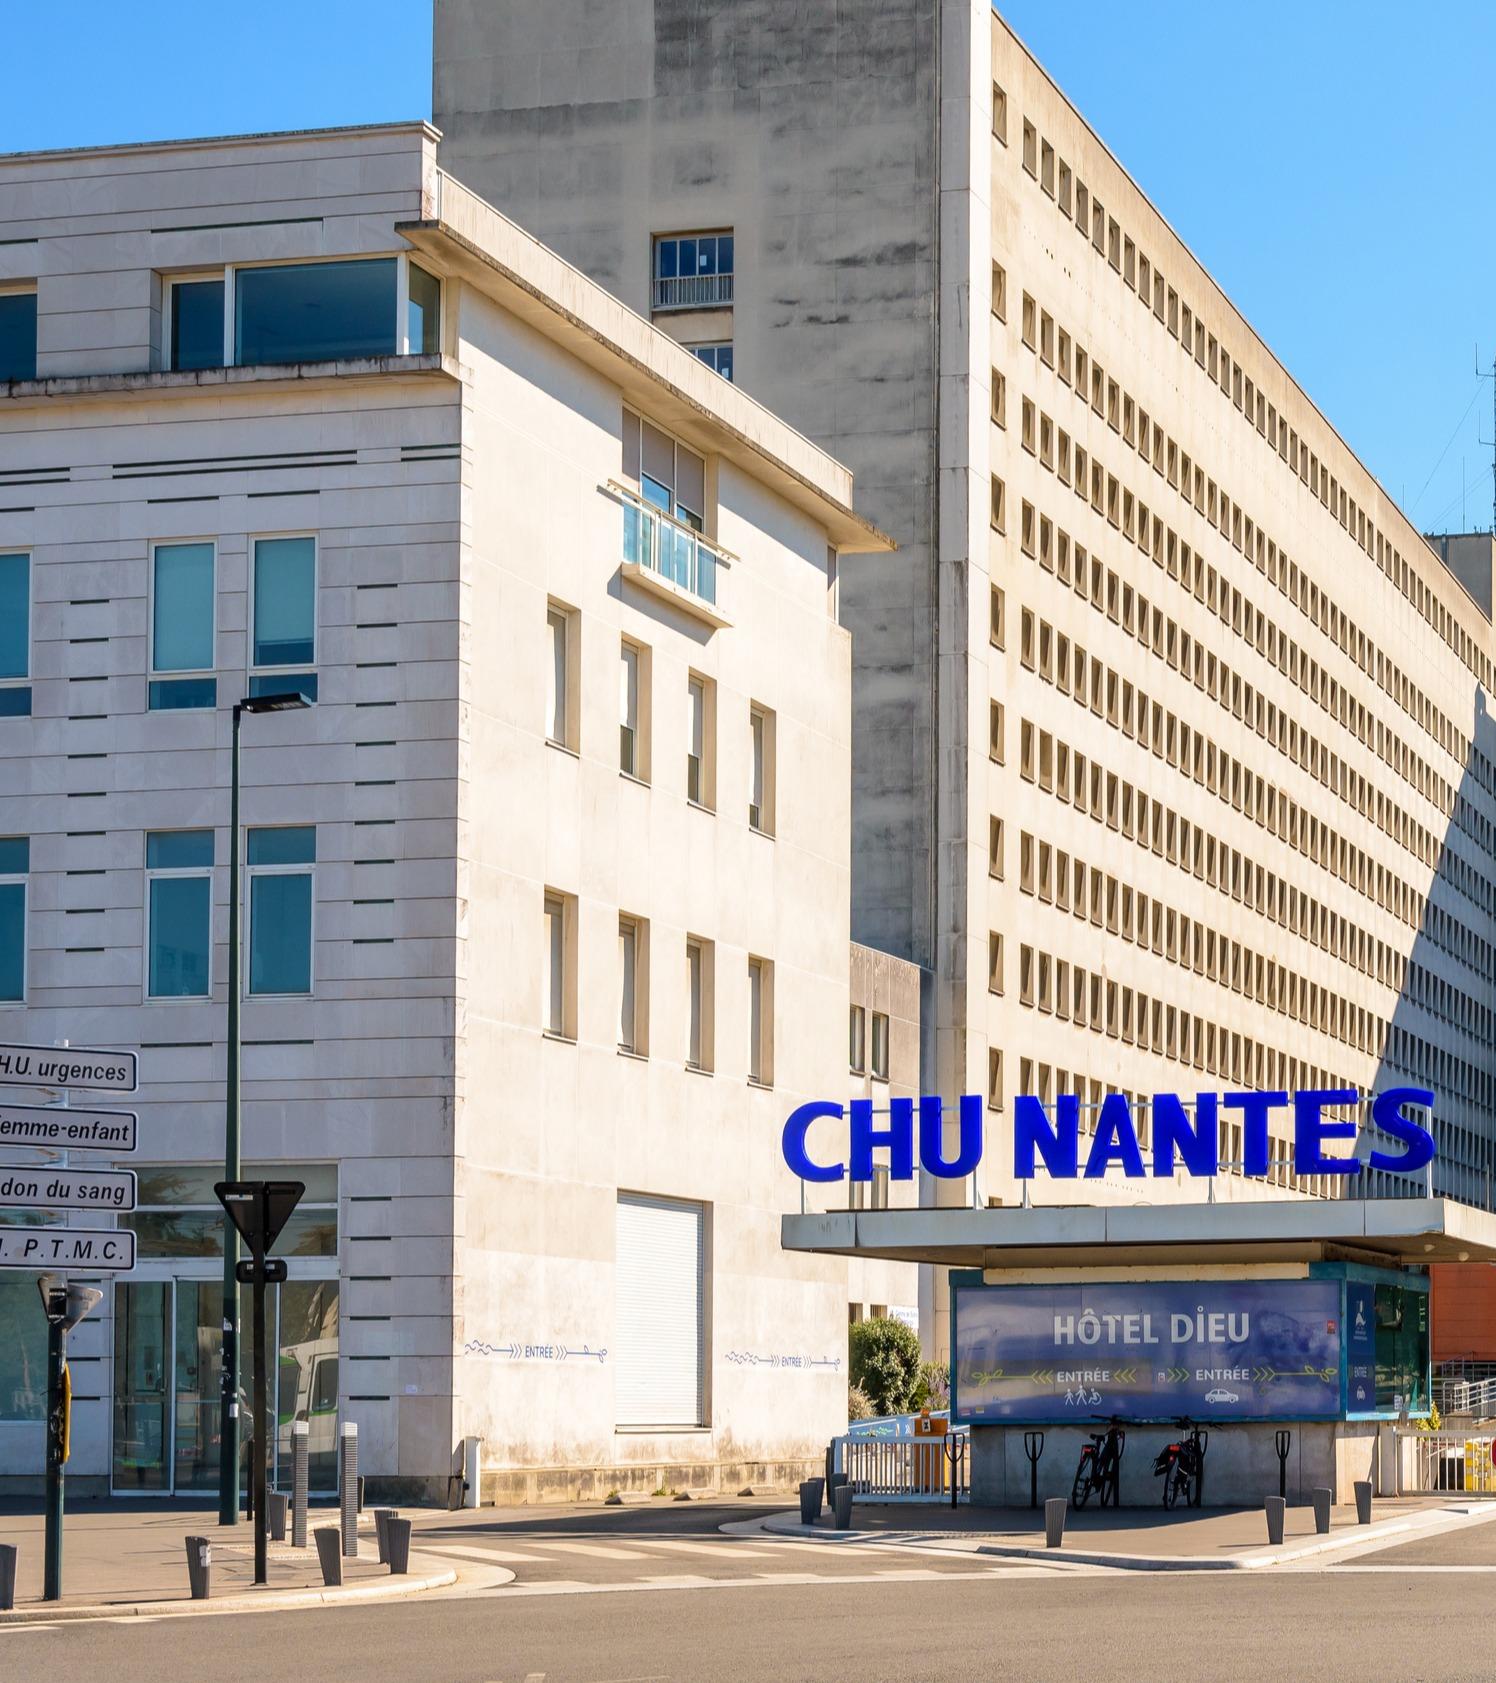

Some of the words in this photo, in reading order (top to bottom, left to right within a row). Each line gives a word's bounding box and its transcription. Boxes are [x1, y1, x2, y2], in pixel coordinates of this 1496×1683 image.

[38, 1061, 127, 1083] urgences
[0, 1115, 130, 1142] emme-enfant
[781, 1095, 983, 1183] CHU
[1014, 1087, 1437, 1179] NANTES
[1, 1177, 38, 1198] don
[46, 1179, 71, 1199] du
[77, 1185, 126, 1205] sang
[1054, 1308, 1159, 1345] HÔTEL
[525, 1344, 554, 1359] ENTRÉE
[781, 1355, 802, 1368] ENTRÉE
[1057, 1366, 1110, 1383] ENTRÉE
[1195, 1365, 1249, 1381] ENTRÉE
